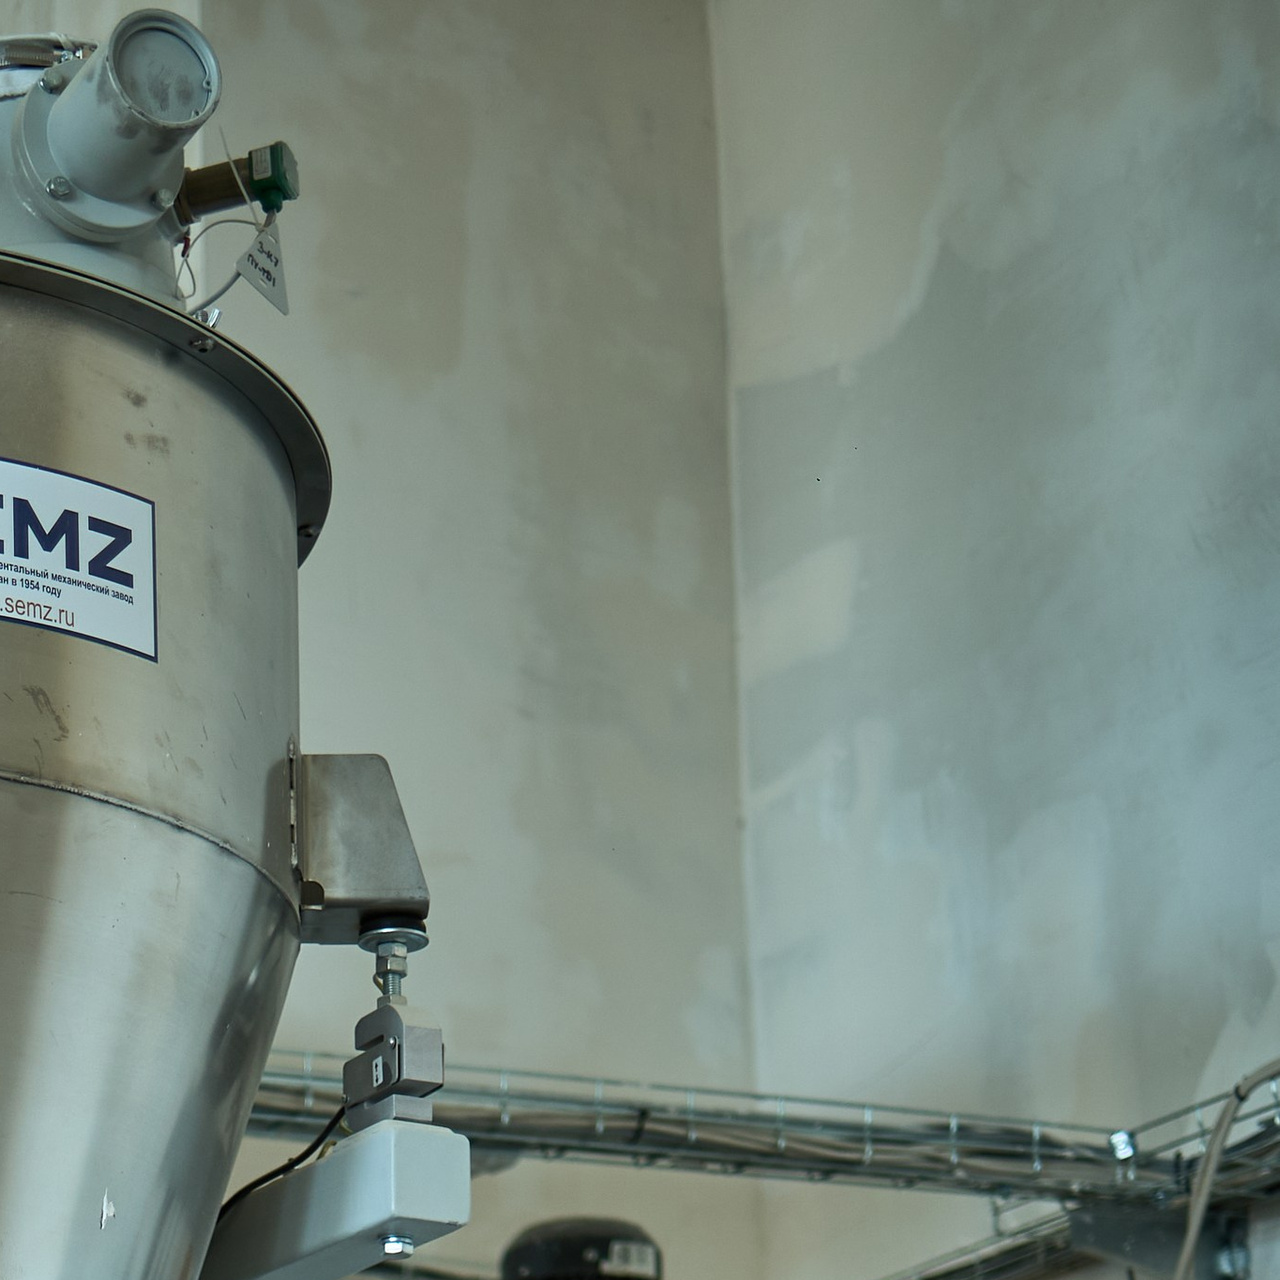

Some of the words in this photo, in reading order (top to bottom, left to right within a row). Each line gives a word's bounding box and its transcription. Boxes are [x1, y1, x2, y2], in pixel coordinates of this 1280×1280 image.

[11, 578, 18, 587] в
[20, 578, 40, 591] 1954
[42, 584, 62, 598] году
[51, 572, 110, 596] механический
[111, 589, 134, 605] завод
